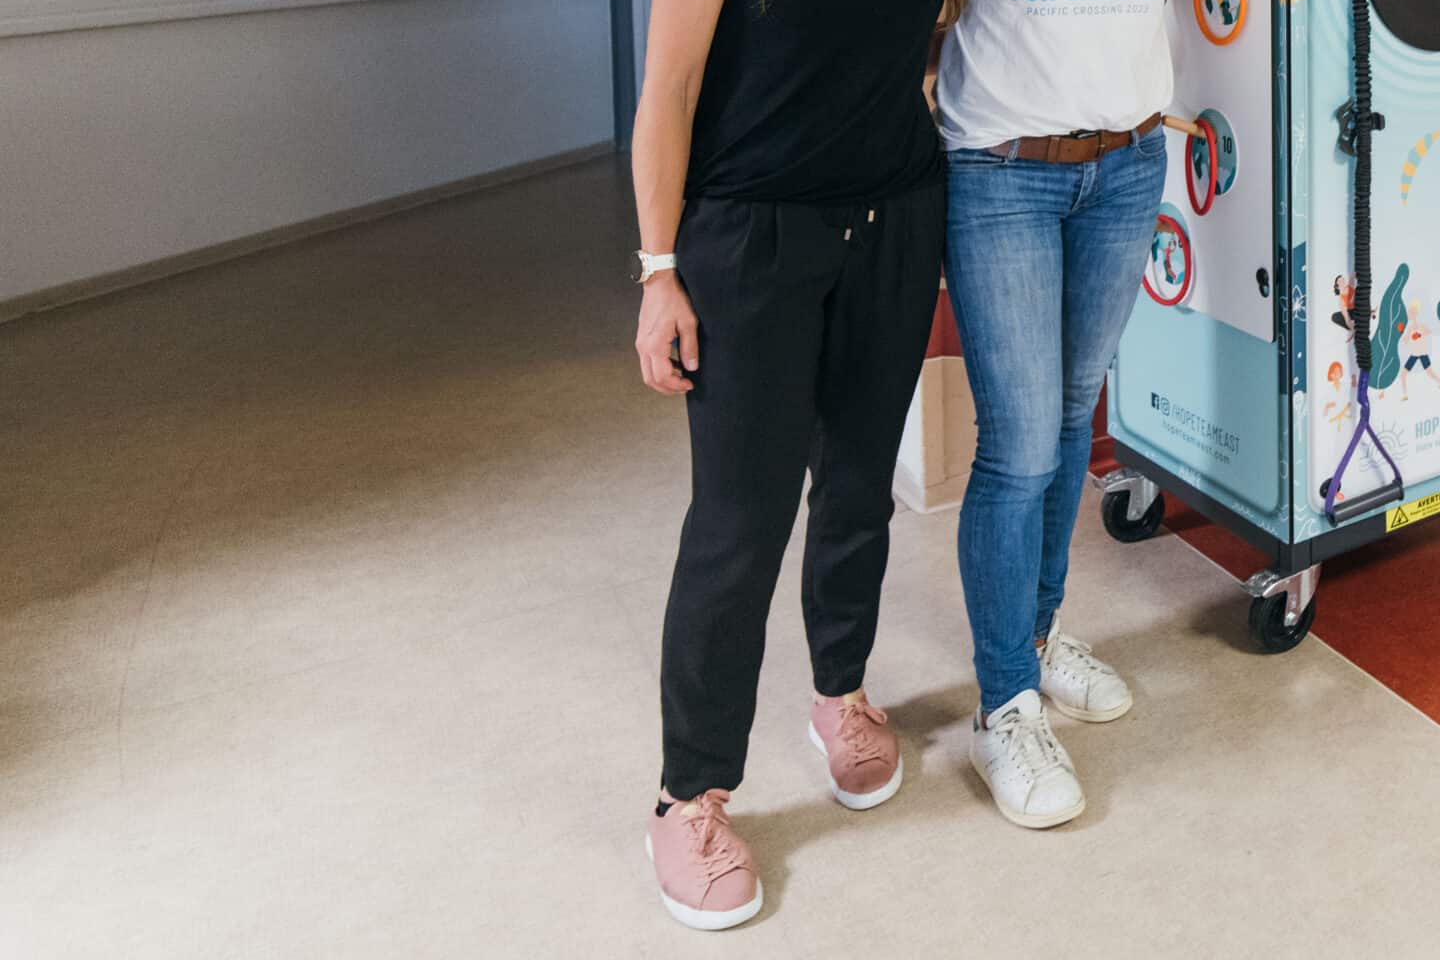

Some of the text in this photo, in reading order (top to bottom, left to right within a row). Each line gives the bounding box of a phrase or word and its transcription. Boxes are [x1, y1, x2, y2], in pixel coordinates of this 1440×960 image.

[1026, 7, 1068, 17] PACIFIC
[1072, 4, 1123, 16] CROSSING
[1222, 135, 1232, 155] 10
